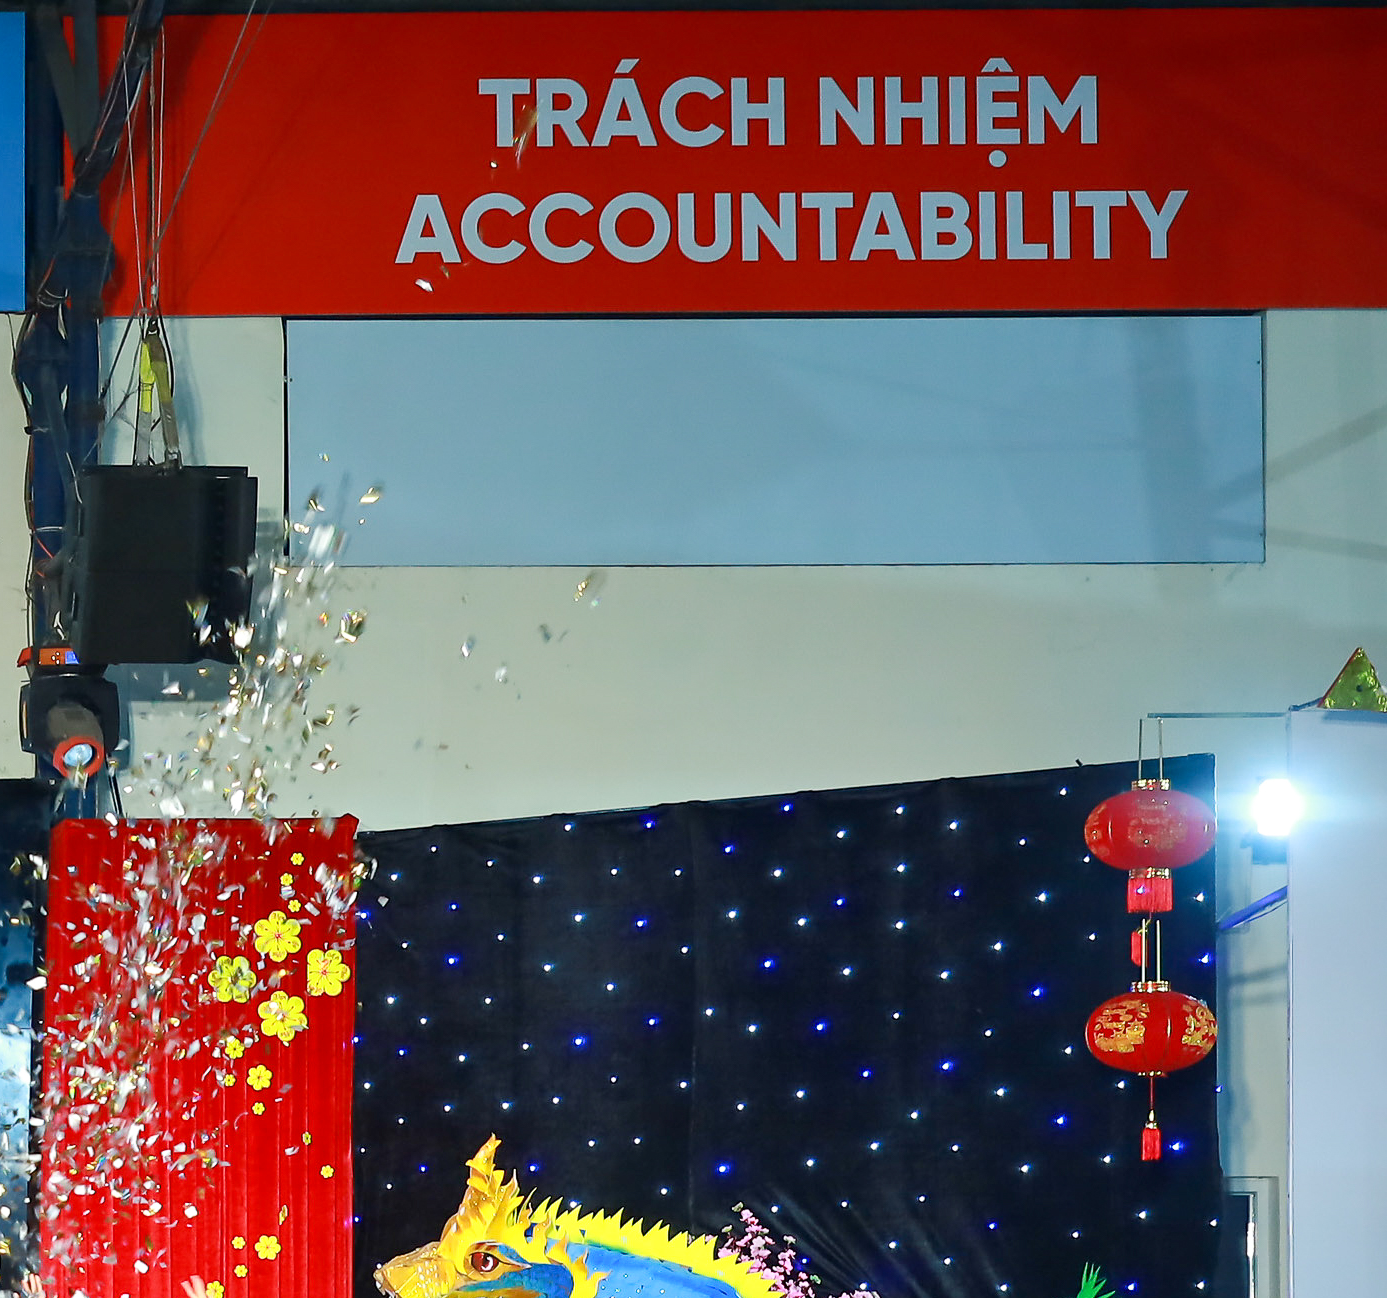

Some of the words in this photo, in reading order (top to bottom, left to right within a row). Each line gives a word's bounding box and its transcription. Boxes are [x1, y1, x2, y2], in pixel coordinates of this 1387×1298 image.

[478, 58, 786, 149] TRÁCH
[819, 57, 1098, 169] NHIỆM
[394, 190, 1189, 265] ACCOUNTABILITY
